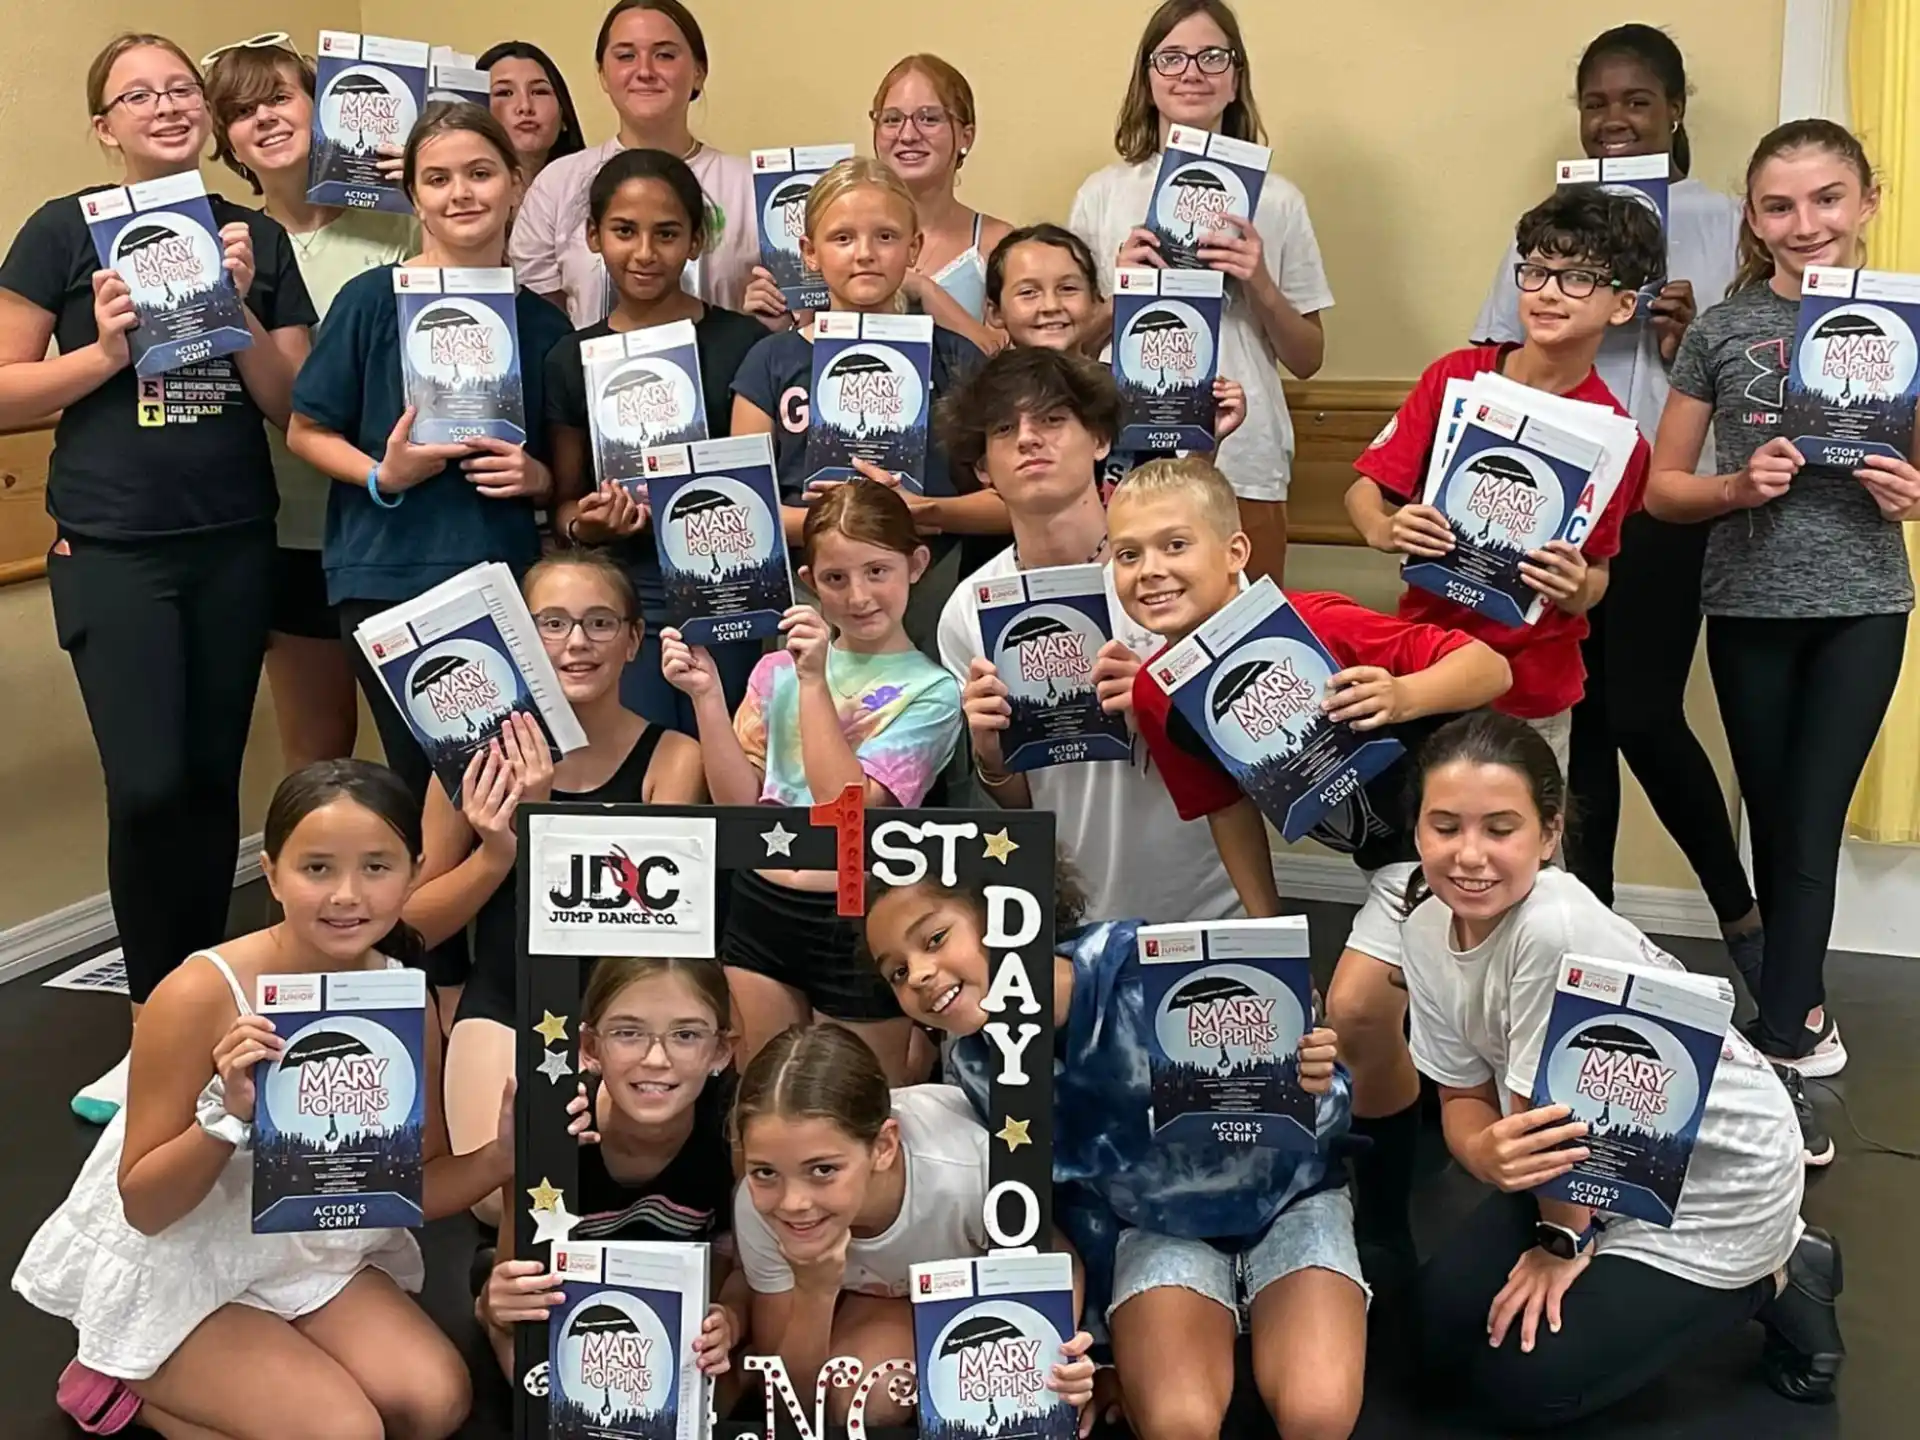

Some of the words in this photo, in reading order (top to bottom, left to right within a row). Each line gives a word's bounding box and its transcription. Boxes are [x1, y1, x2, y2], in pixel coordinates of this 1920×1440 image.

[341, 92, 400, 118] MARY
[340, 114, 399, 134] POPPINS
[344, 191, 380, 202] ACTOR'S
[347, 199, 376, 209] SCRIPT
[1178, 187, 1236, 214] MARY
[133, 235, 194, 274] MARY
[138, 256, 203, 289] POPPINS
[431, 325, 493, 349] MARY
[1143, 331, 1199, 354] MARY
[175, 339, 213, 358] ACTOR'S
[181, 347, 211, 363] SCRIPT
[431, 347, 495, 365] POPPINS
[1824, 336, 1900, 364] MARY
[1141, 351, 1197, 370] POPPINS
[1822, 357, 1896, 381] POPPINS
[143, 381, 159, 397] E
[184, 391, 226, 400] EFFORT
[841, 374, 903, 397] MARY
[618, 380, 676, 415] MARY
[840, 398, 903, 414] POPPINS
[143, 405, 159, 421] T
[184, 405, 223, 414] TRAIN
[617, 403, 679, 427] POPPINS
[448, 427, 486, 436] ACTOR'S
[1147, 431, 1182, 441] ACTOR'S
[1151, 440, 1178, 449] SCRIPT
[1822, 446, 1865, 459] ACTOR'S
[1826, 455, 1860, 467] SCRIPT
[1473, 476, 1548, 516] MARY
[684, 505, 750, 543] MARY
[1466, 494, 1537, 534] POPPINS
[686, 529, 755, 557] POPPINS
[1444, 578, 1486, 603] ACTOR'S
[1445, 590, 1479, 610] SCRIPT
[711, 620, 752, 633] ACTOR'S
[716, 628, 749, 642] SCRIPT
[1019, 632, 1086, 667] MARY
[1022, 656, 1092, 682] POPPINS
[426, 659, 488, 709] MARY
[1230, 656, 1301, 727] MARY
[434, 679, 501, 723] POPPINS
[1242, 677, 1316, 742] POPPINS
[1048, 742, 1089, 755] ACTOR'S
[1053, 752, 1085, 762] SCRIPT
[1318, 767, 1358, 802] ACTOR'S
[1327, 779, 1361, 807] SCRIPT
[549, 911, 594, 925] JUMP
[598, 912, 652, 925] DANCE
[654, 913, 678, 926] CO.
[1188, 998, 1277, 1031] MARY
[1189, 1024, 1279, 1048] POPPINS
[1251, 1043, 1272, 1056] JR
[299, 1058, 390, 1097] MARY
[1582, 1047, 1678, 1093] MARY
[299, 1088, 390, 1116] POPPINS
[1576, 1075, 1669, 1117] POPPINS
[360, 1111, 380, 1126] JR
[1211, 1122, 1263, 1133] ACTOR'S
[1633, 1110, 1654, 1128] JR
[1218, 1132, 1258, 1143] SCRIPT
[1567, 1179, 1620, 1200] ACTOR'S
[1571, 1190, 1613, 1208] SCRIPT
[313, 1203, 367, 1217] ACTOR'S
[319, 1215, 361, 1228] SCRIPT
[582, 1333, 654, 1370] MARY
[959, 1340, 1041, 1383] MARY
[581, 1363, 653, 1391] POPPINS
[959, 1370, 1045, 1402] POPPINS
[628, 1391, 644, 1405] JR
[1017, 1393, 1036, 1408] JR
